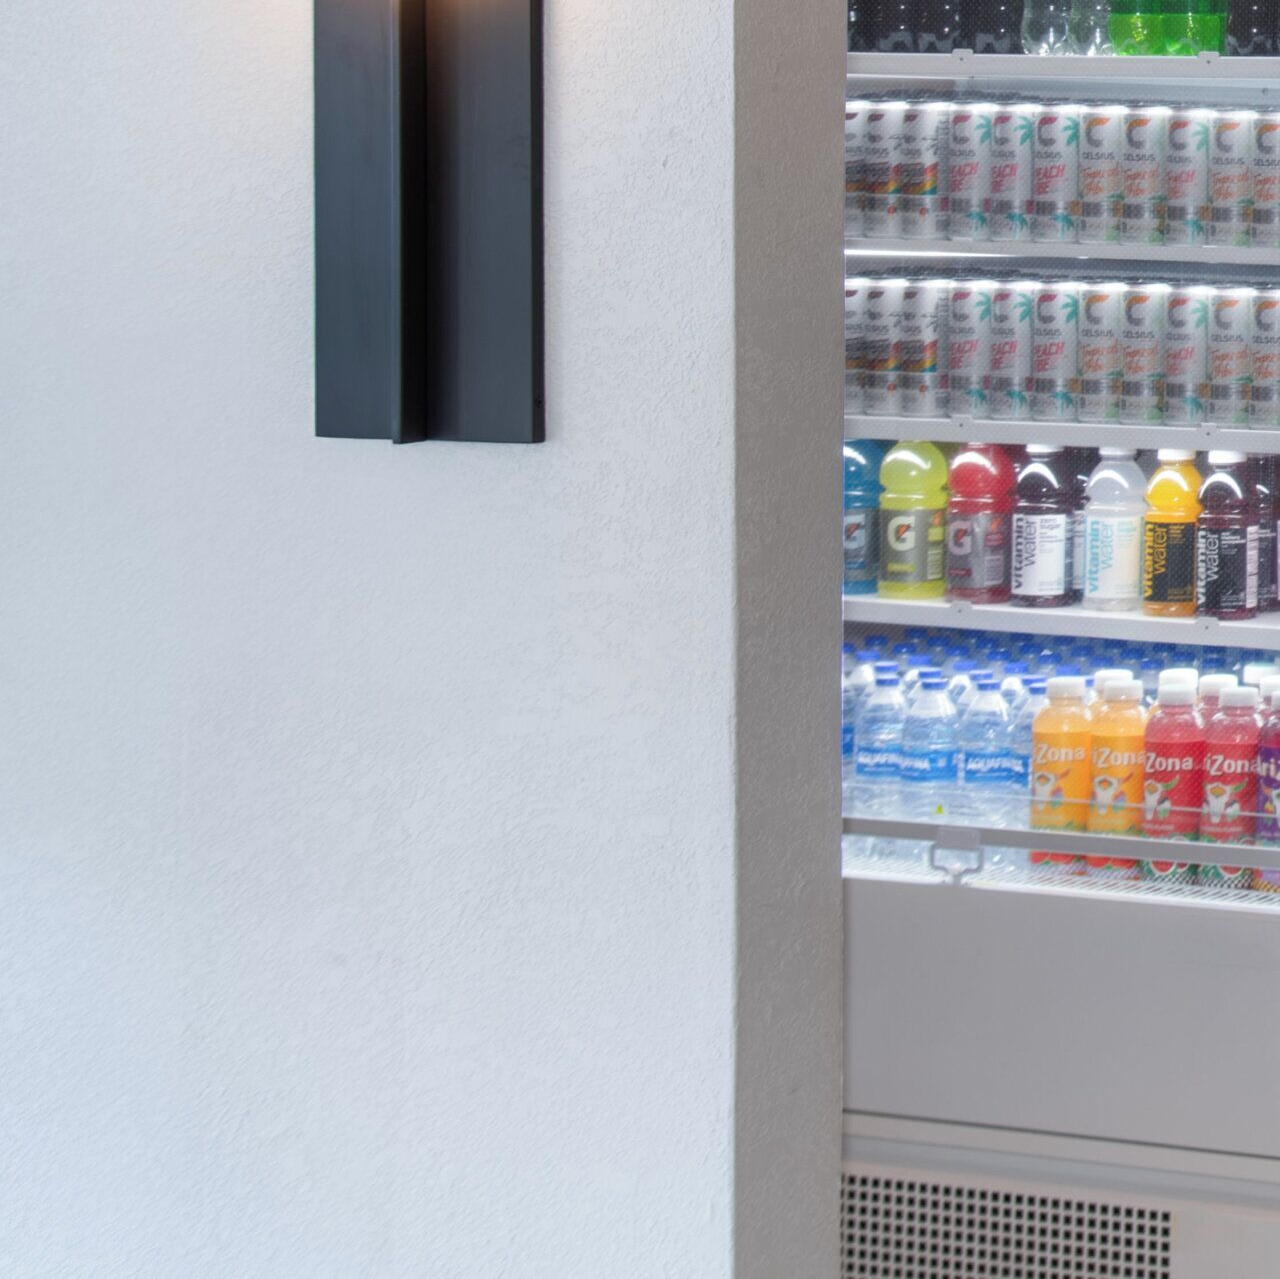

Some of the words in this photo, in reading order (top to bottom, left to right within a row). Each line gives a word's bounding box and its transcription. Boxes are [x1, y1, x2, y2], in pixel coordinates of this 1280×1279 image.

[887, 516, 915, 551] G
[1014, 518, 1024, 589] vitamin
[1024, 518, 1037, 568] water
[1088, 519, 1099, 594] vitamin
[1101, 523, 1113, 570] water
[1153, 526, 1167, 575] water
[1207, 532, 1219, 581] water
[1143, 524, 1153, 597] vitamin
[1197, 529, 1207, 605] vitamin
